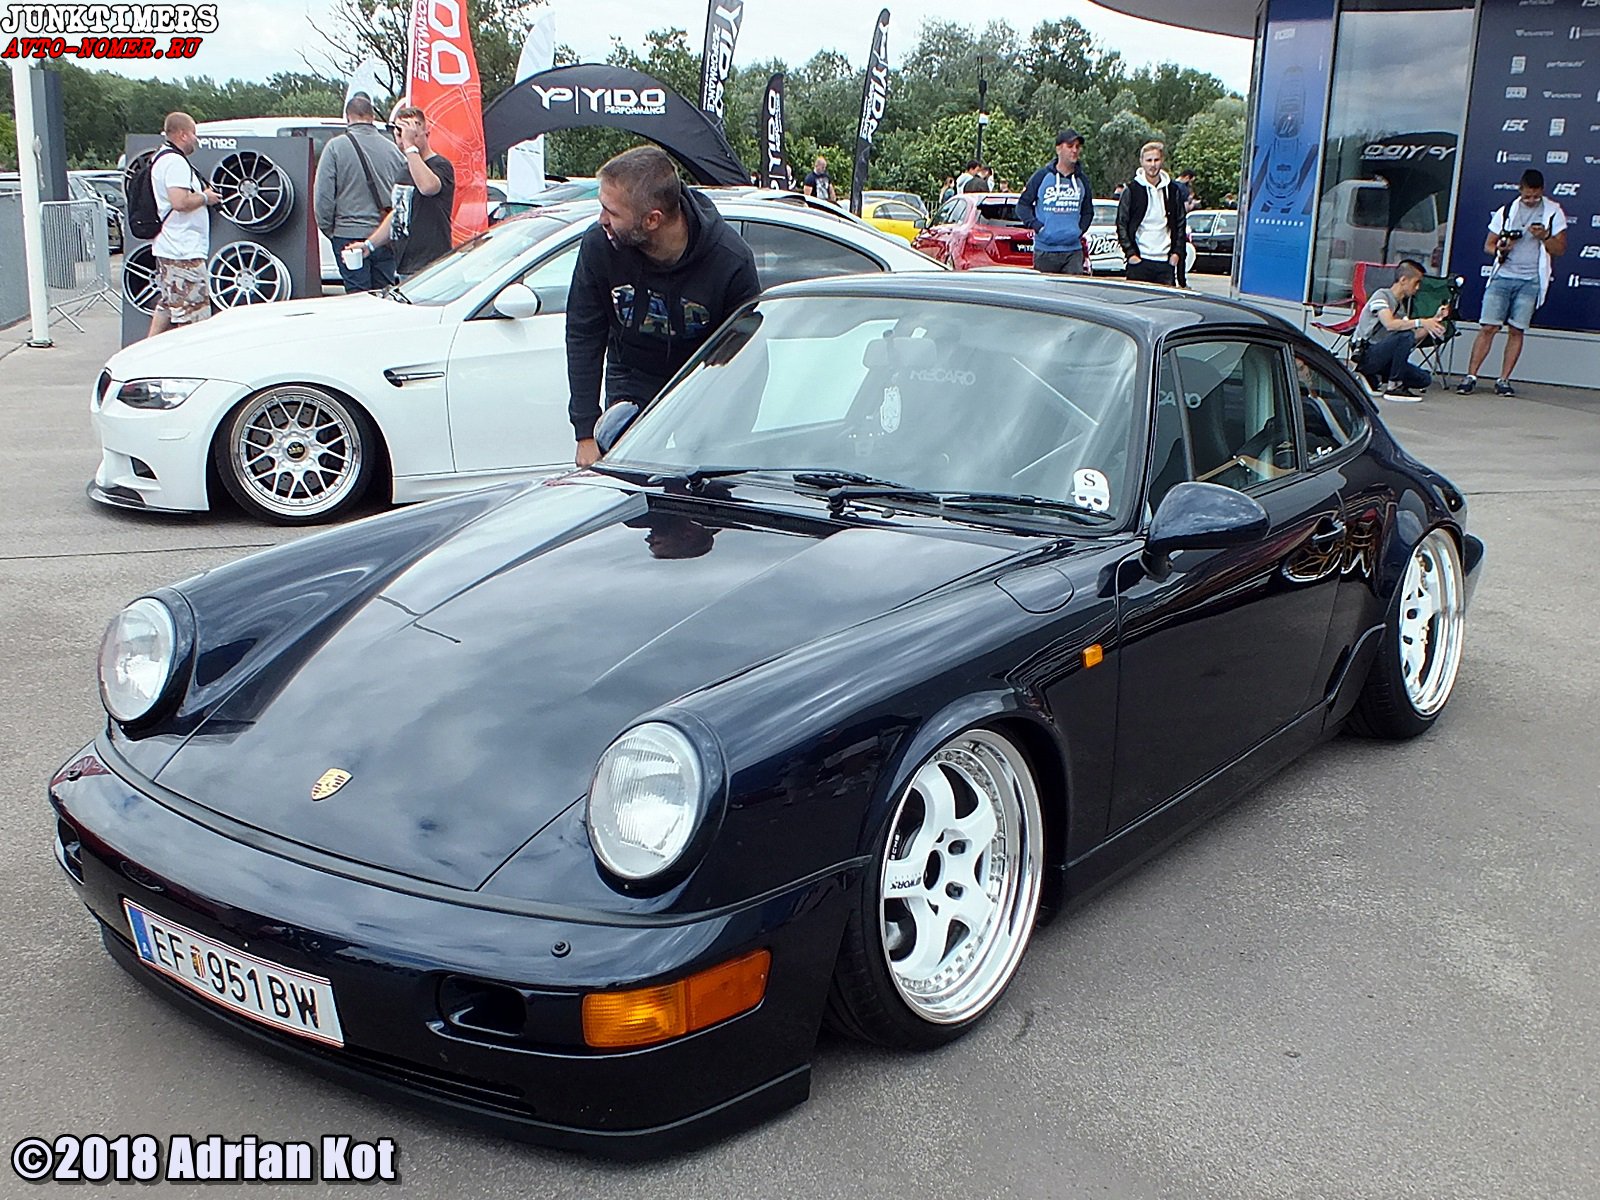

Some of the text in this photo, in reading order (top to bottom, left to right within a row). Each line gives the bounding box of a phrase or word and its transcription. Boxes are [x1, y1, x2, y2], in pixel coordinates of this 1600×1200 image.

[417, 0, 430, 83] ORMANCE
[581, 88, 666, 112] YIDO
[604, 105, 666, 115] PERFORMANCE
[1158, 390, 1202, 409] CAO
[1084, 472, 1096, 487] S
[151, 923, 185, 971] EF
